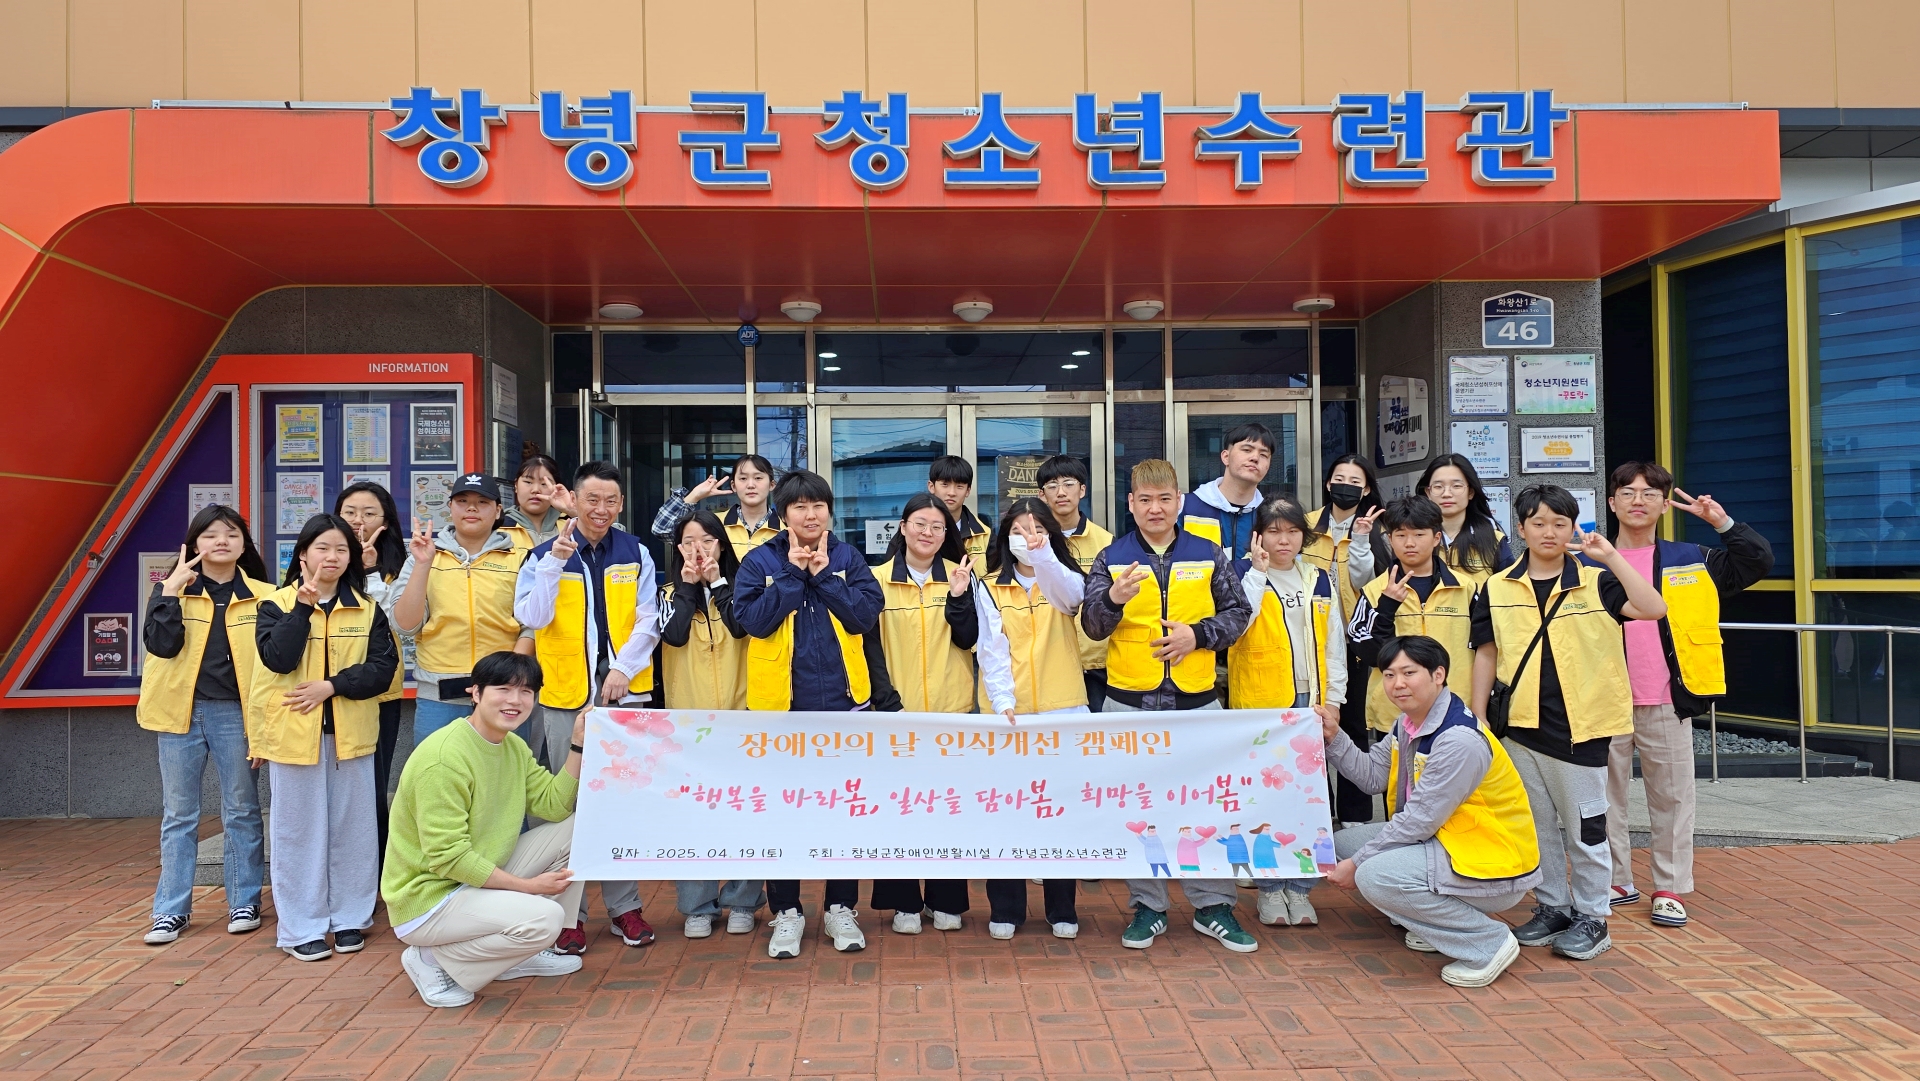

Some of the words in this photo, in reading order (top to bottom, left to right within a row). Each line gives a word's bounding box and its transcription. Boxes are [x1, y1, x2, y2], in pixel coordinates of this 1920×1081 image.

[380, 86, 1570, 191] 창녕군청소년수련관
[1497, 297, 1538, 308] 화왕산1로
[741, 330, 755, 338] ADT
[1498, 321, 1539, 341] 46
[368, 362, 449, 373] INFORMATION
[1524, 377, 1589, 388] 청소년지원센터
[417, 419, 451, 427] 국제청소년
[417, 427, 451, 435] 성취포상제
[737, 730, 874, 758] 장애인의
[889, 731, 921, 757] 날
[935, 729, 1060, 757] 인식개선
[1074, 729, 1172, 757] 캠페인
[782, 777, 879, 818] 바라봄,
[890, 787, 962, 816] 일상을
[975, 779, 1065, 819] 담아봄,
[1081, 781, 1154, 811] 희망을
[611, 846, 640, 860] 일자
[656, 847, 701, 859] 2025.
[706, 847, 732, 859] 04.
[739, 847, 755, 859] 19
[761, 847, 783, 859] (토)
[808, 847, 833, 859] 주최
[851, 846, 991, 860] 창녕군장애인생활시설
[1011, 846, 1128, 860] 창녕군청소년수련관
